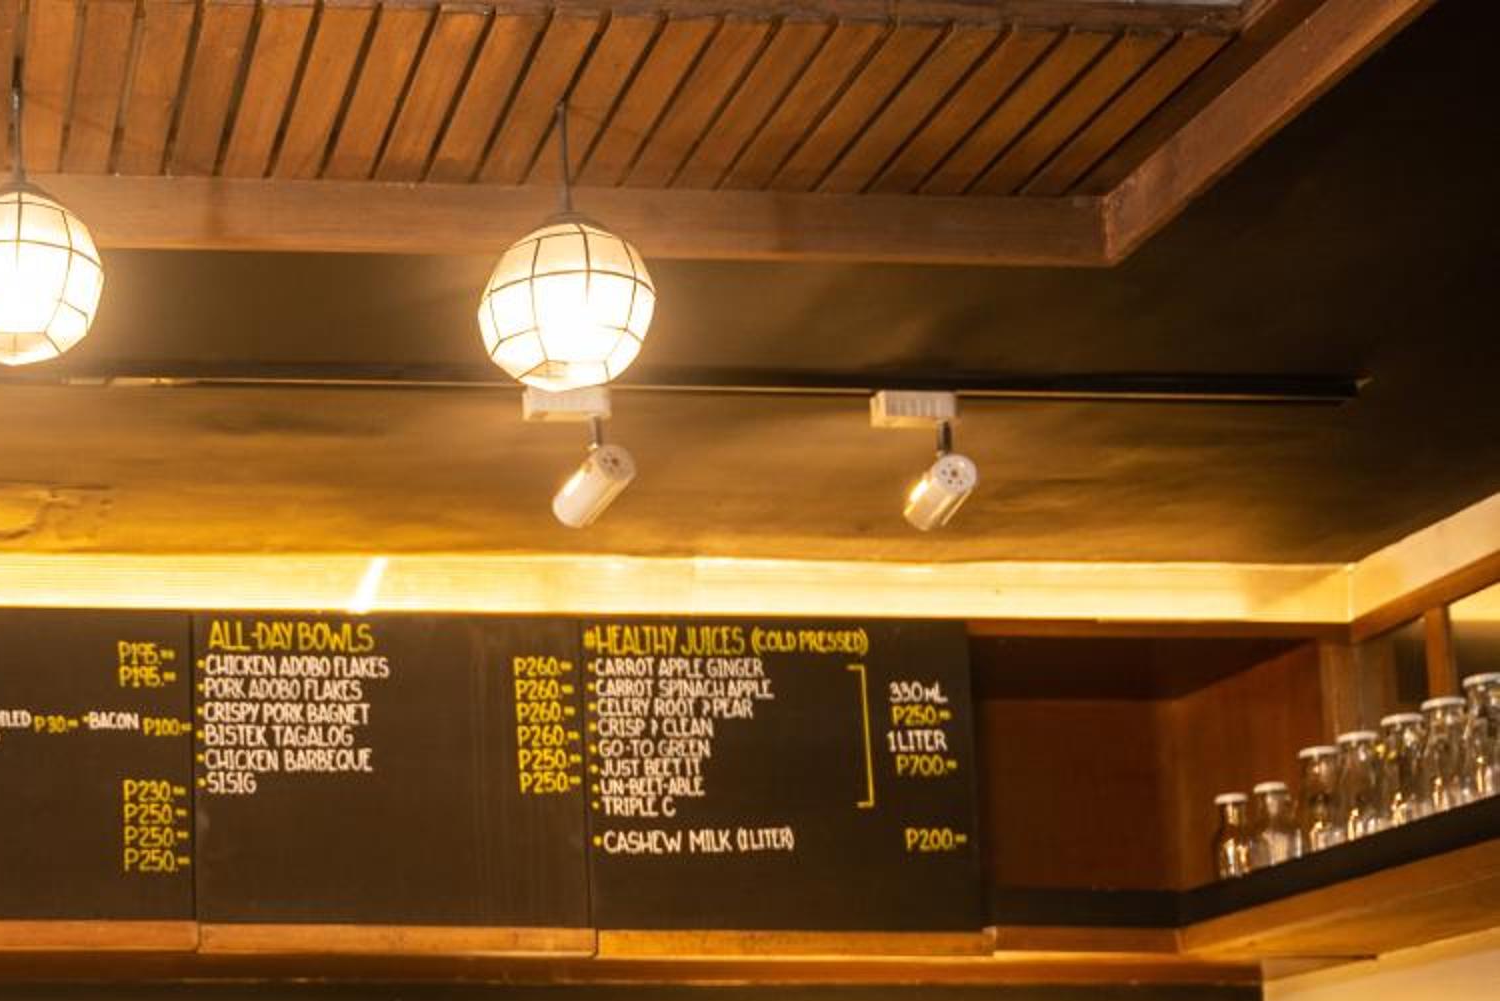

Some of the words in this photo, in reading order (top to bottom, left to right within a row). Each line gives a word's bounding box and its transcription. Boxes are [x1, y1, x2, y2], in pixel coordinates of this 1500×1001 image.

[209, 620, 294, 652] ALL-DAY
[298, 622, 374, 652] BOWLS
[681, 626, 744, 656] JUICES
[752, 626, 797, 656] (COLD
[800, 628, 869, 656] PRESSED)
[206, 654, 276, 676] CHICKEN
[280, 656, 330, 677] ADOBO
[334, 656, 390, 678] FLAKES
[595, 658, 654, 676] CARROT
[658, 658, 704, 678] APPLE
[706, 658, 764, 678] GINGER
[204, 678, 245, 698] PORK
[249, 679, 300, 700] ADOBO
[304, 679, 363, 702] FLAKES
[595, 678, 653, 698] CARROT
[659, 679, 726, 698] SPINACH
[728, 679, 775, 700] APPLE
[204, 702, 260, 722] CRISPY
[263, 703, 304, 724] PORK
[307, 704, 370, 725] BAGNET
[596, 699, 650, 717] CELERY
[654, 699, 695, 718] ROOT
[714, 700, 754, 719] PEAR
[88, 712, 139, 730] BACON
[598, 718, 646, 738] CRISP
[662, 718, 714, 738] CLEAN
[204, 724, 268, 746] BISTEK
[272, 725, 354, 746] TAGALOG
[598, 738, 655, 758] GO-TO
[658, 739, 712, 758] GREEN
[205, 748, 279, 770] CHICKEN
[284, 748, 372, 772] BARBEQUE
[601, 758, 640, 777] JUST
[644, 758, 681, 777] BEET
[686, 758, 700, 777] IT
[206, 772, 257, 794] SISIG
[602, 796, 658, 816] TRIPLE
[662, 796, 676, 817] C
[604, 830, 682, 854] CASHEW
[690, 828, 732, 852] MILK
